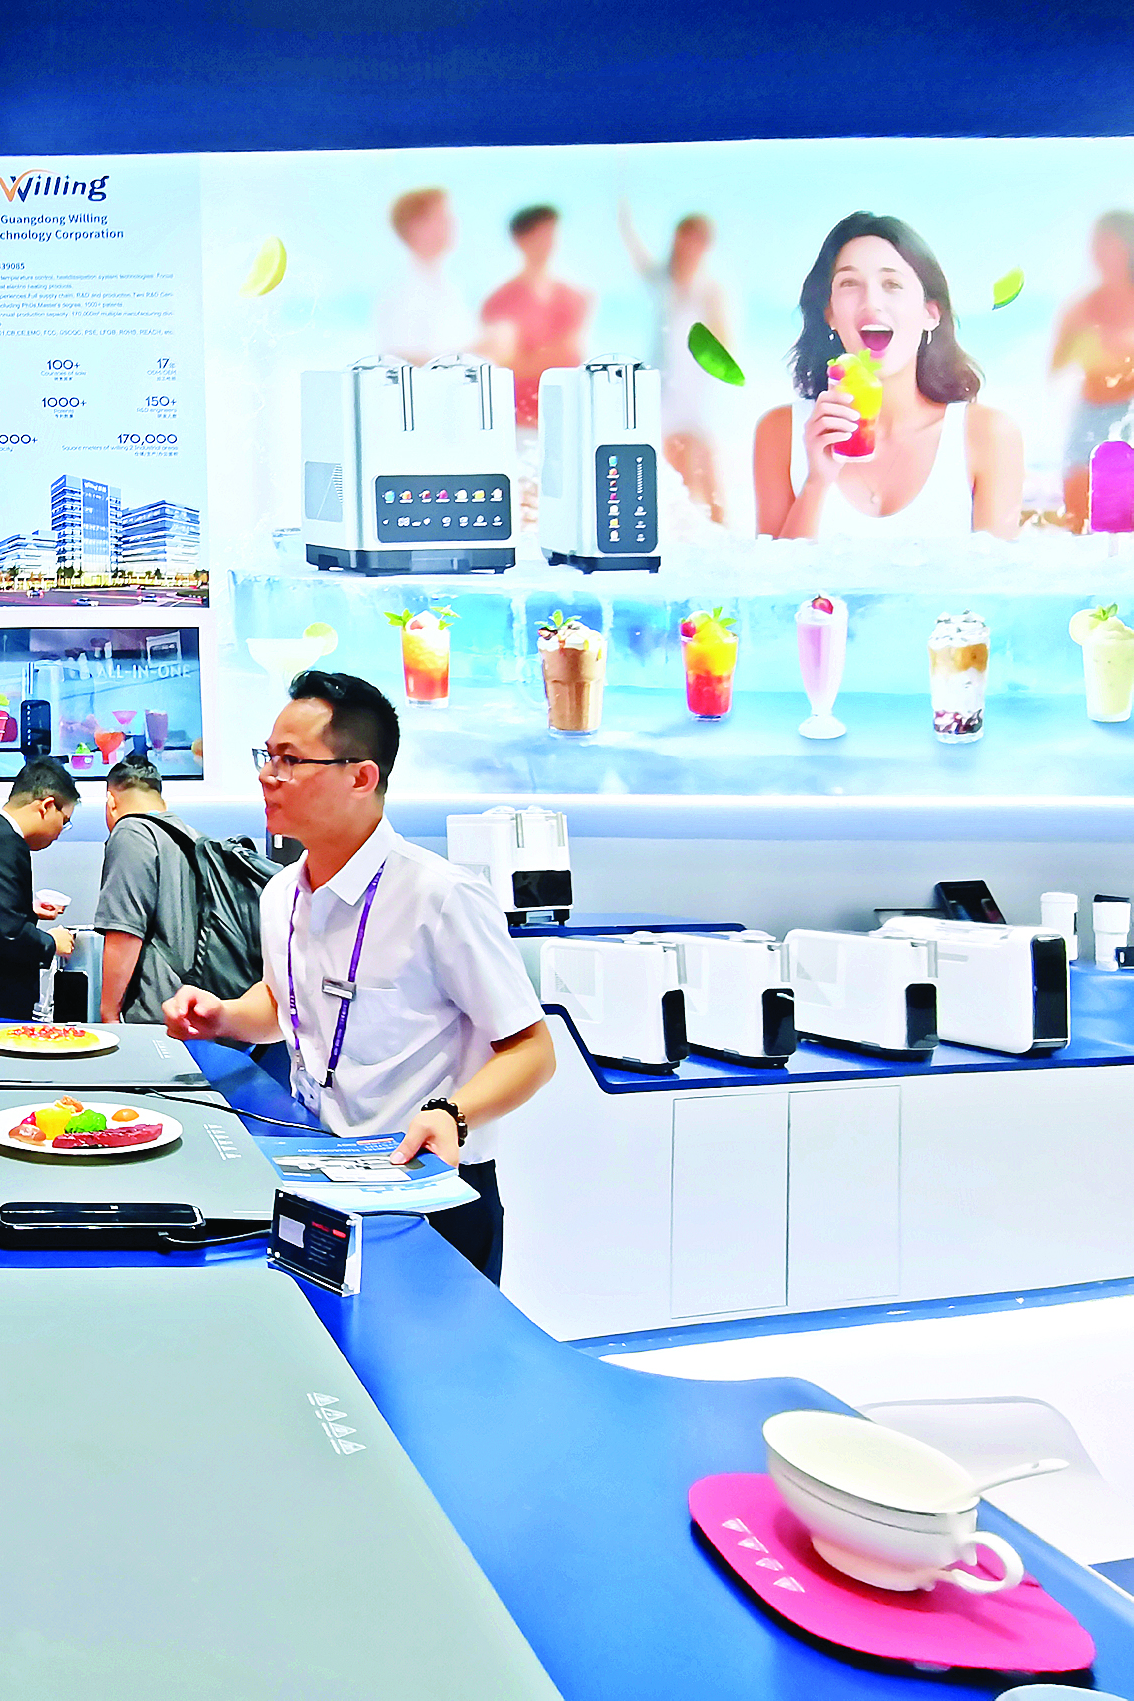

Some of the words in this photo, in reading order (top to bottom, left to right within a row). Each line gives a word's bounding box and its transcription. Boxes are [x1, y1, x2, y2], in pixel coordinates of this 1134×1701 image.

[0, 214, 66, 226] Guangdong
[68, 213, 108, 226] Willing
[55, 229, 124, 242] Corporation
[46, 359, 80, 370] 100+
[42, 397, 87, 408] 1000+
[145, 396, 177, 407] 150+
[117, 433, 177, 446] 170,000
[96, 662, 191, 680] ALL-IN-ONE
